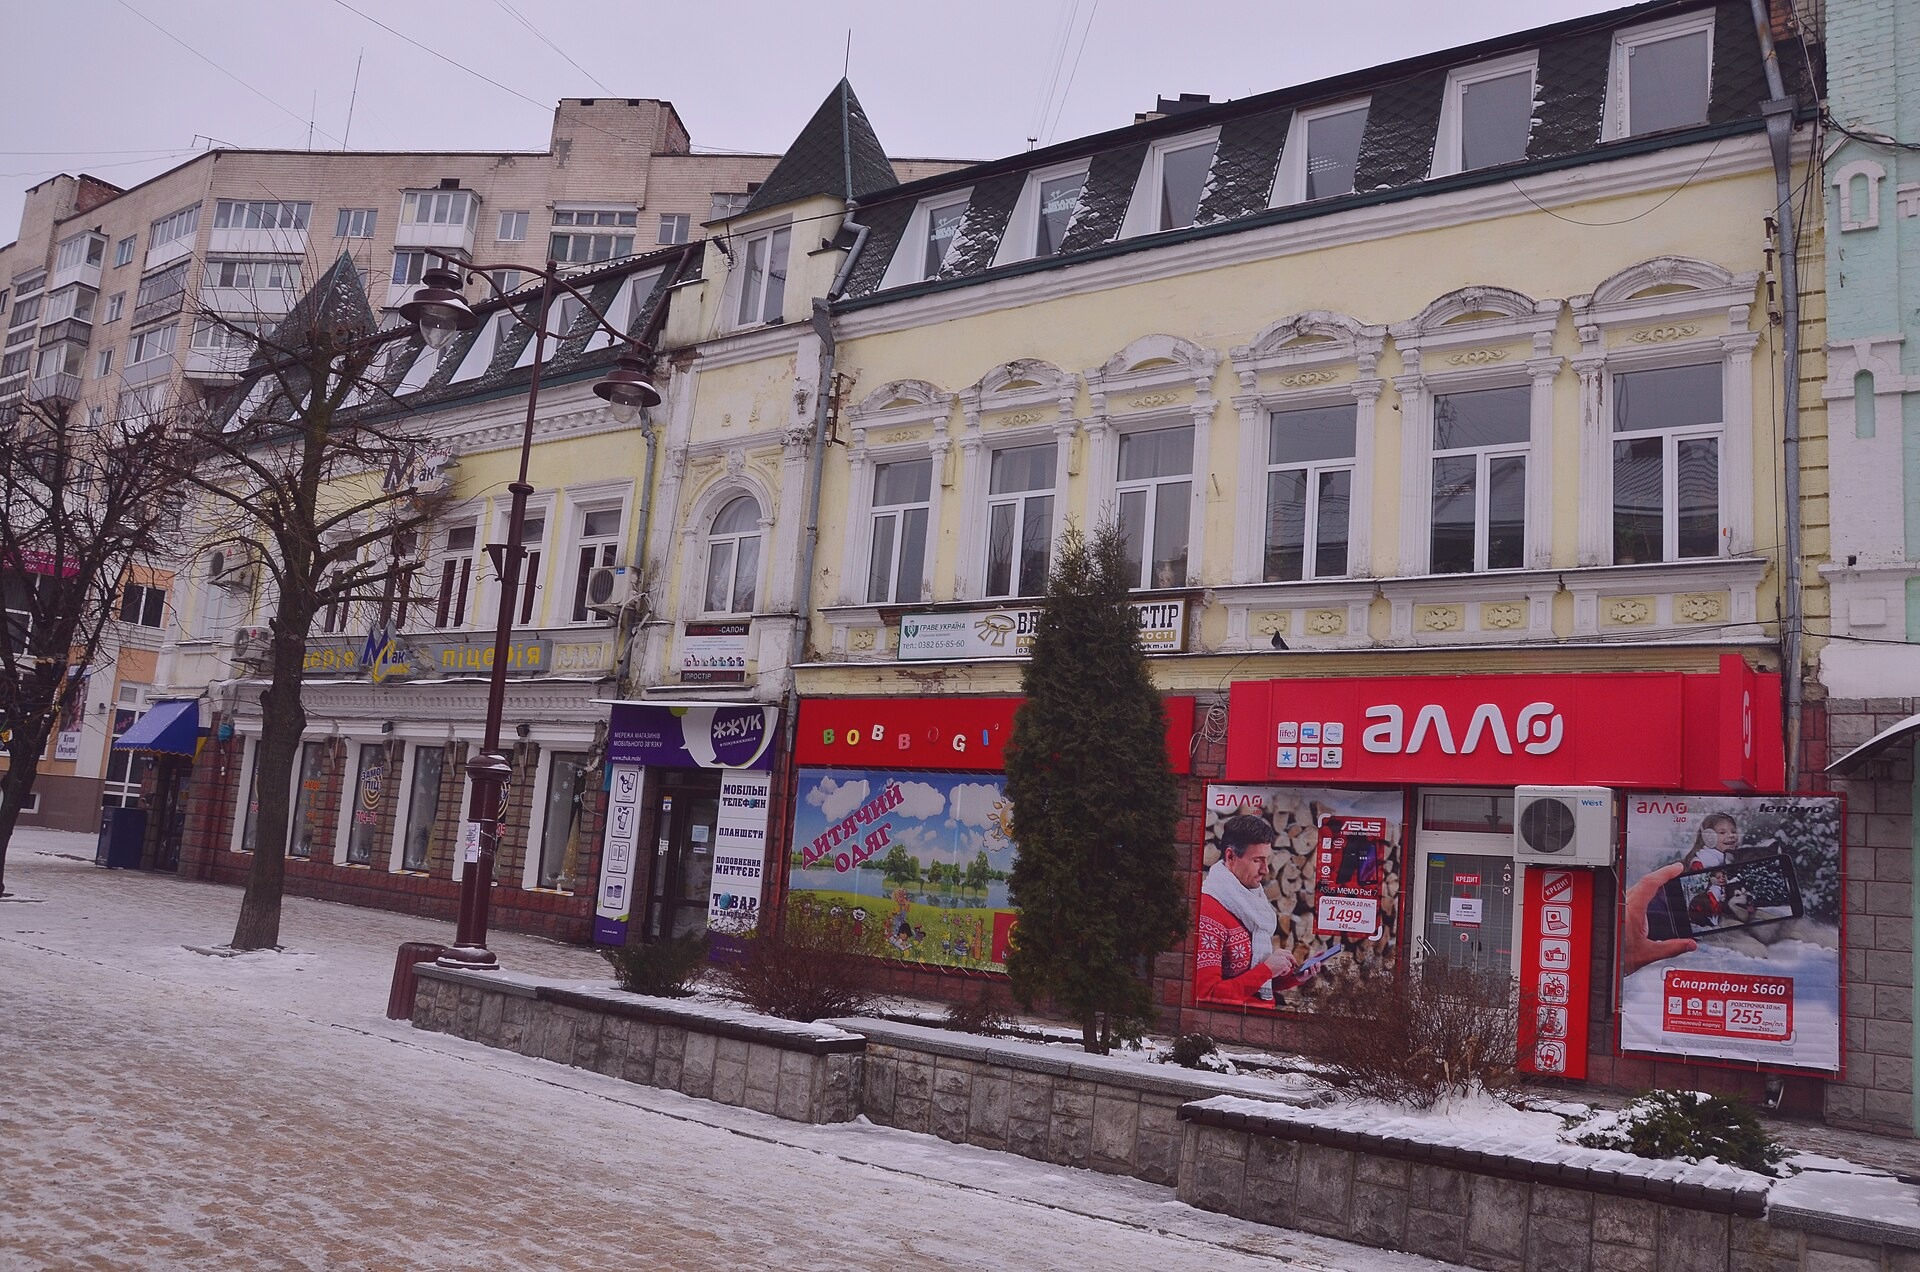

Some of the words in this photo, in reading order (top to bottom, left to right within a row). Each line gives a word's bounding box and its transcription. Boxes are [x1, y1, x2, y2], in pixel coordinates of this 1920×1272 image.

[918, 640, 935, 648] 0382
[936, 639, 965, 648] 65-85-60
[723, 784, 768, 796] МОБІЛЬНІ
[1758, 803, 1824, 814] lenovo
[802, 783, 904, 870] ДИТЯЧИЙ
[1341, 821, 1381, 832] ASUS
[718, 827, 764, 839] ПЛАНШЕТИ
[834, 823, 892, 873] ОДЯГ
[716, 856, 761, 867] ПОПОВНЕННЯ
[714, 865, 760, 877] МИТТЄВЕ
[1455, 875, 1479, 883] КРЕДИТ
[1320, 886, 1336, 894] ASUS
[1360, 888, 1372, 896] Pad
[1545, 879, 1569, 896] КРЕДИТ
[713, 893, 757, 910] ТВАР
[1326, 906, 1363, 923] 1499
[1672, 977, 1748, 994] Смартфон
[1751, 983, 1786, 996] S660
[1730, 1008, 1763, 1025] 255
